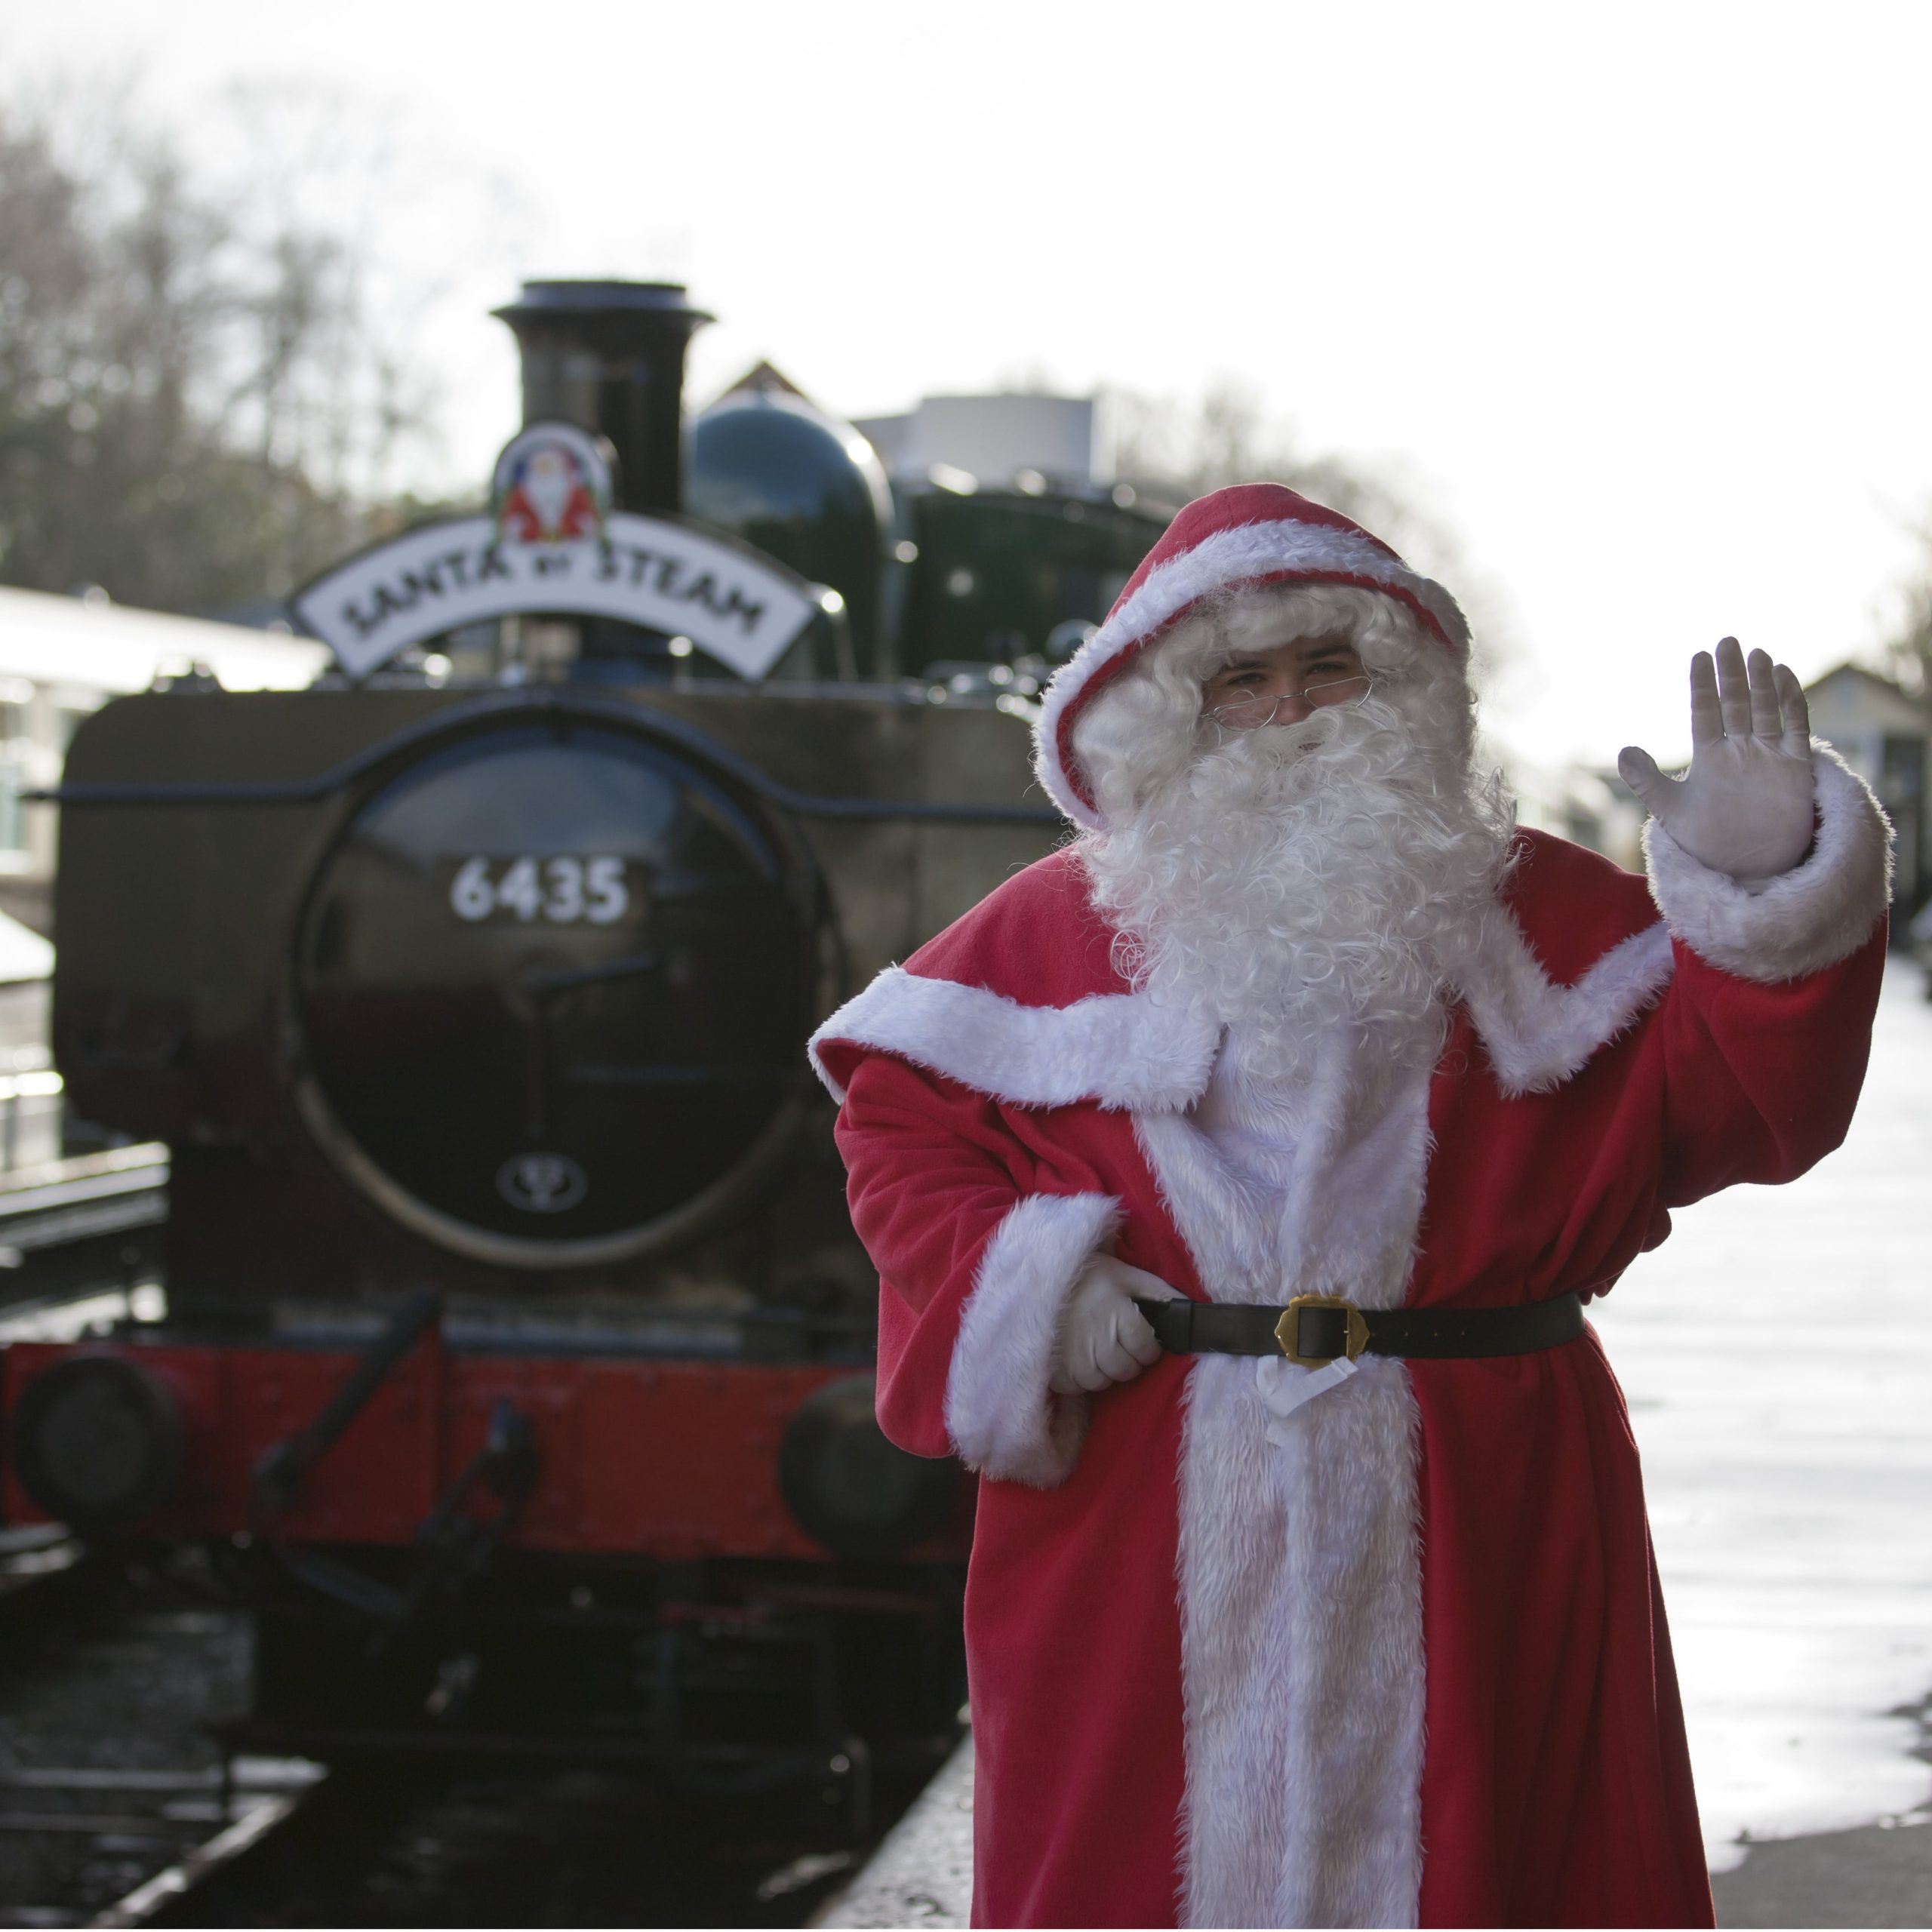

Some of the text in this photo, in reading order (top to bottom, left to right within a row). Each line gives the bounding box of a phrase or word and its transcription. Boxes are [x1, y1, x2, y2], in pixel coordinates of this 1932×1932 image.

[343, 545, 511, 635] SANTA
[595, 543, 766, 635] STEAM
[451, 856, 629, 924] 6435
